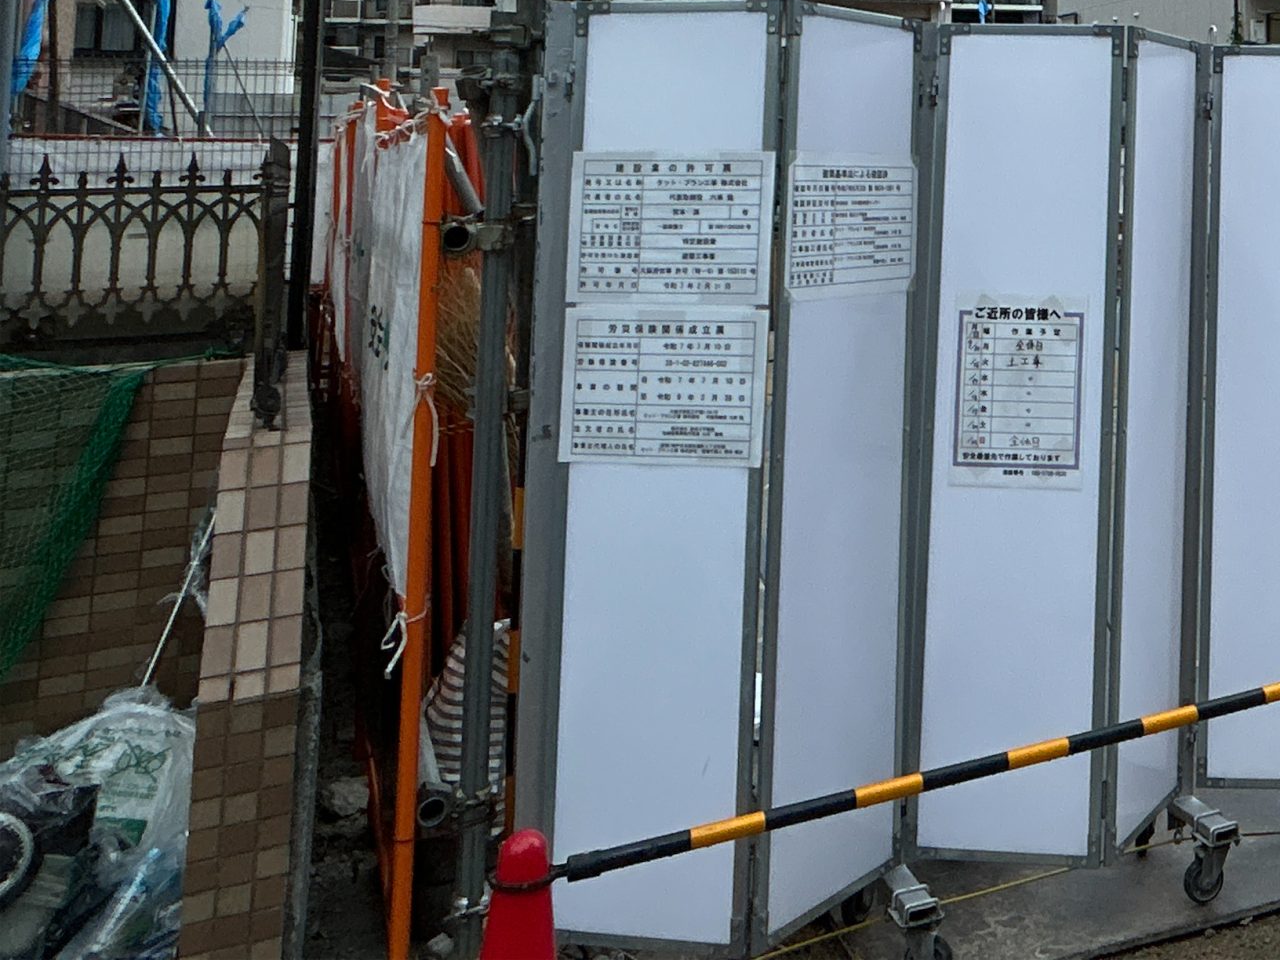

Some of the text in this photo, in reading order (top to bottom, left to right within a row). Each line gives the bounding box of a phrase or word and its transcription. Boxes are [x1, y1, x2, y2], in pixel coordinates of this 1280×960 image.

[974, 306, 1062, 320] ご近所の皆様へ
